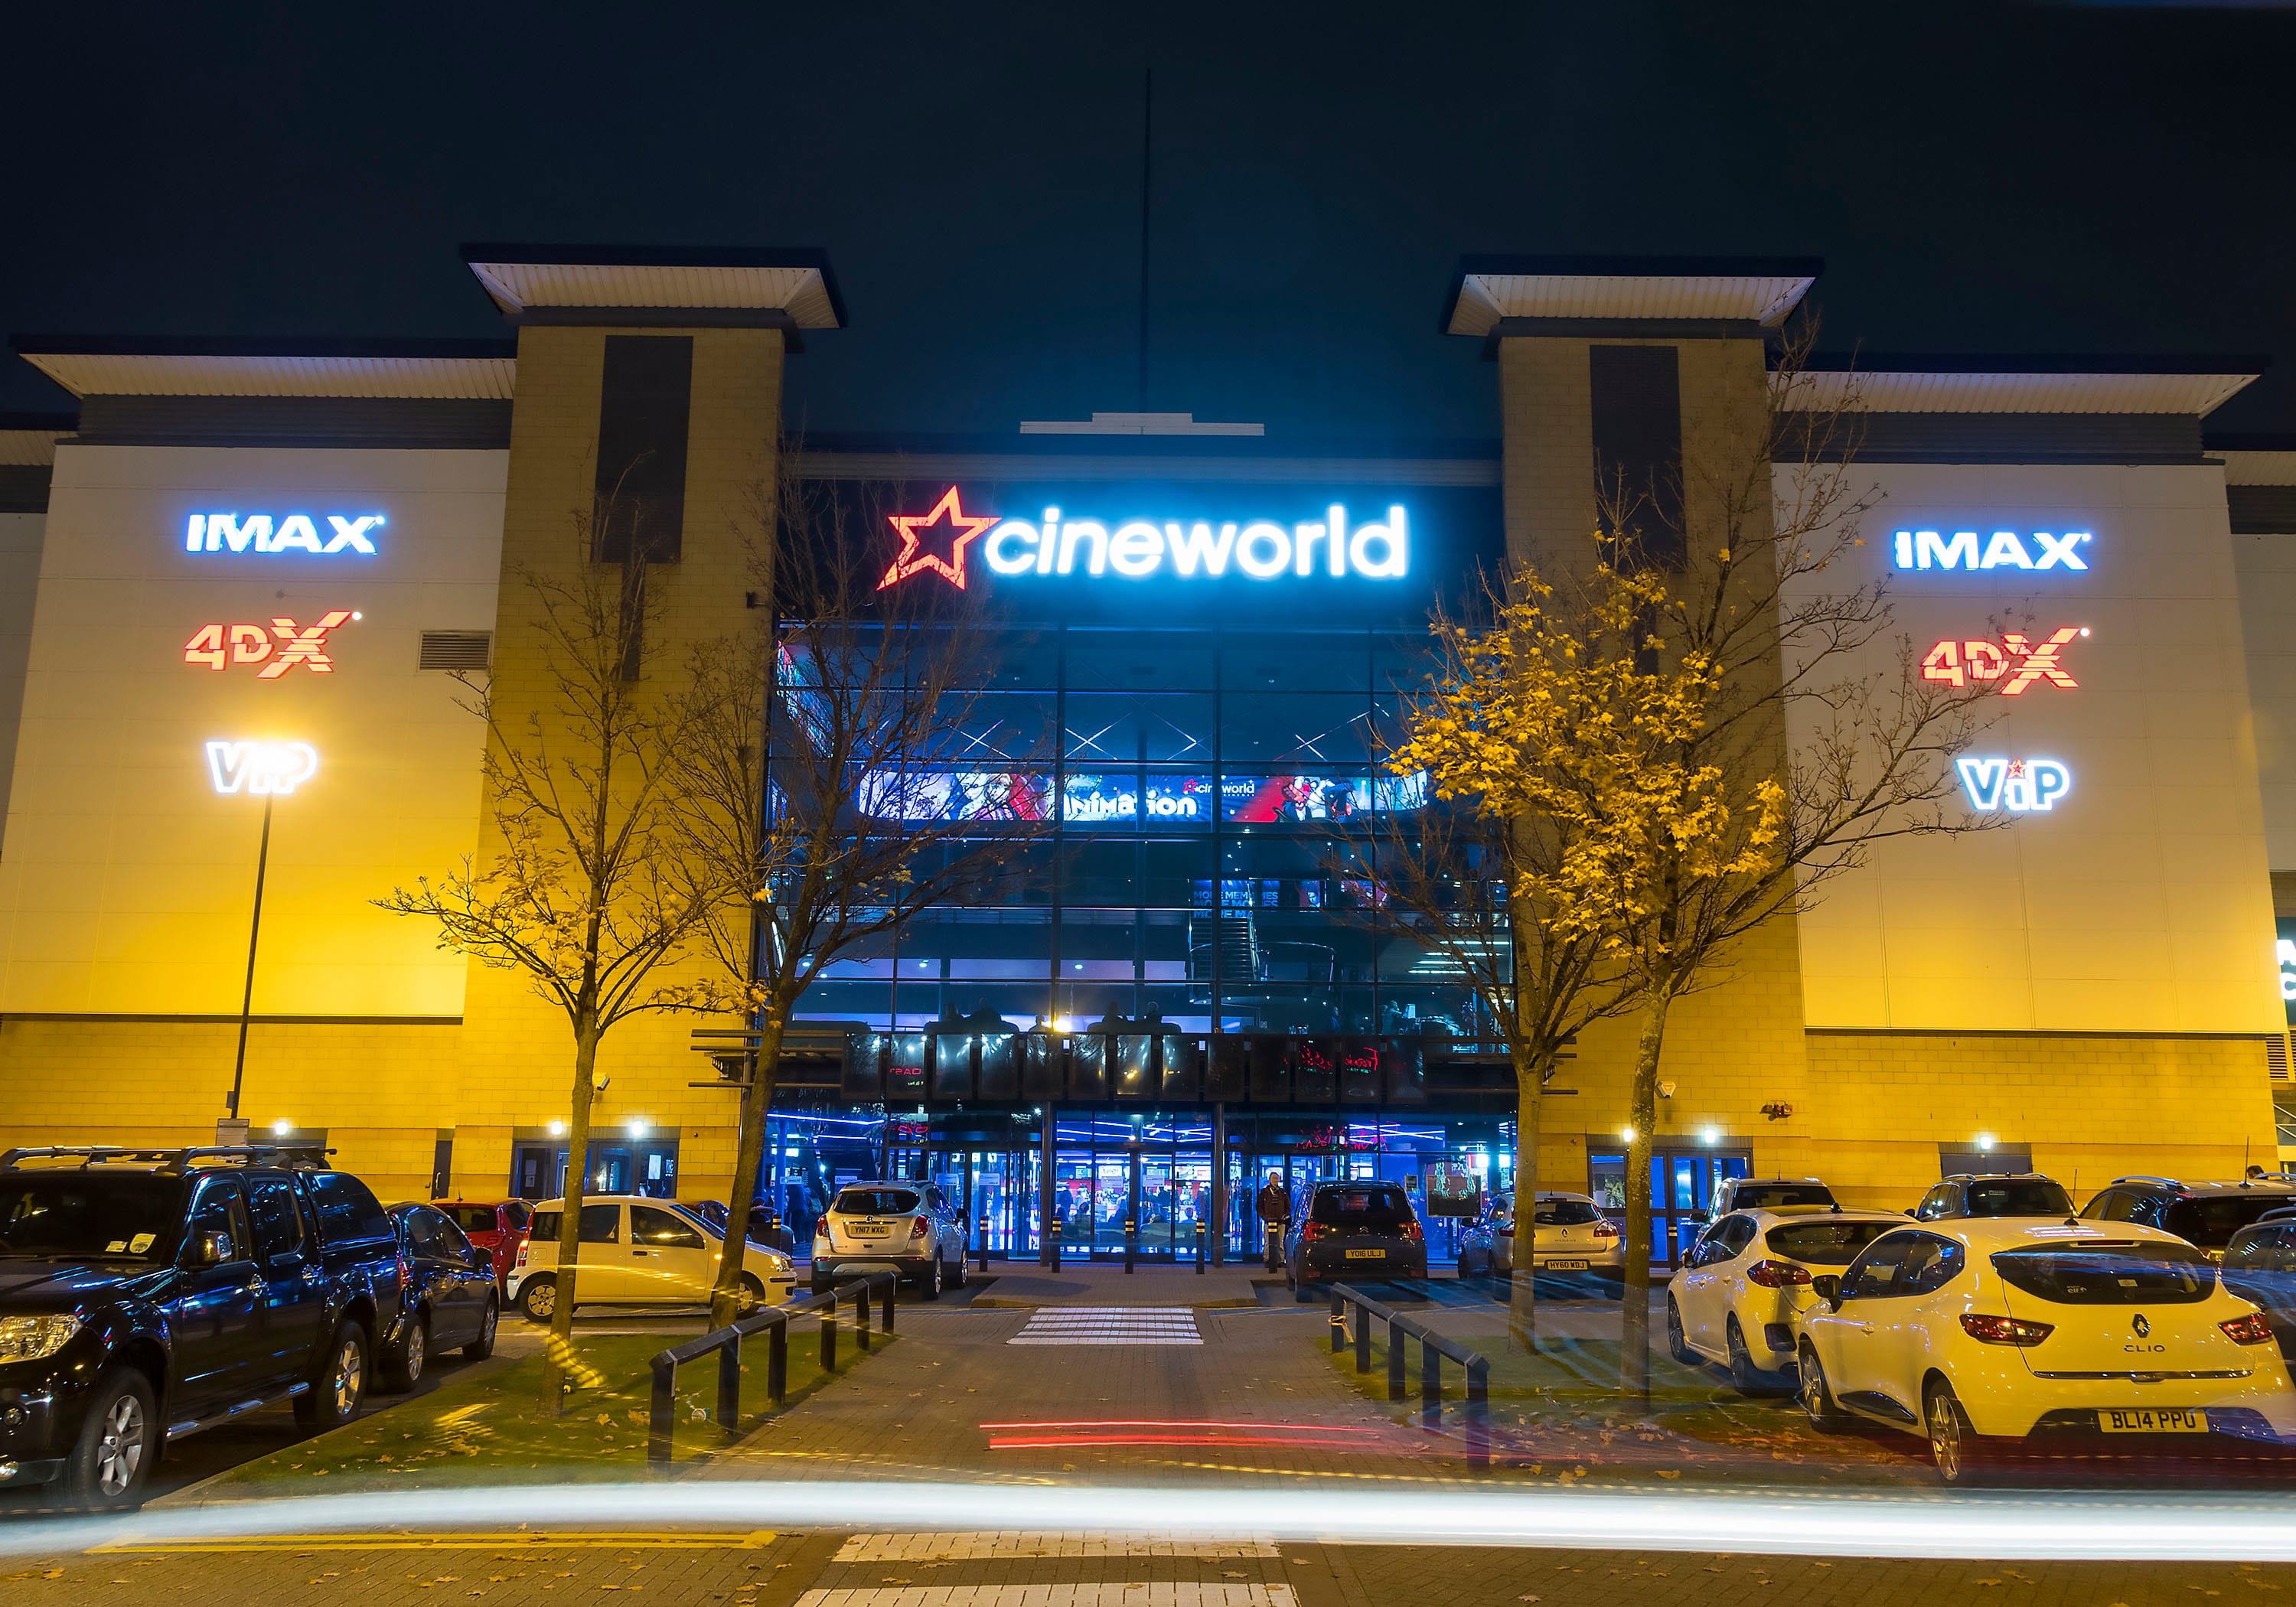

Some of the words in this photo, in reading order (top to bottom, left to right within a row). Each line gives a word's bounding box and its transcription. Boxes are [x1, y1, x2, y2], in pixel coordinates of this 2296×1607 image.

[186, 513, 377, 553] IMAX
[985, 506, 1406, 577] cineworld
[1895, 531, 2089, 570] IMAX
[184, 611, 351, 680] 4DX
[1922, 627, 2081, 696] 4DX
[2124, 1345, 2166, 1353] CLIO
[2110, 1411, 2154, 1429] BL14
[2157, 1411, 2197, 1429] PPU
